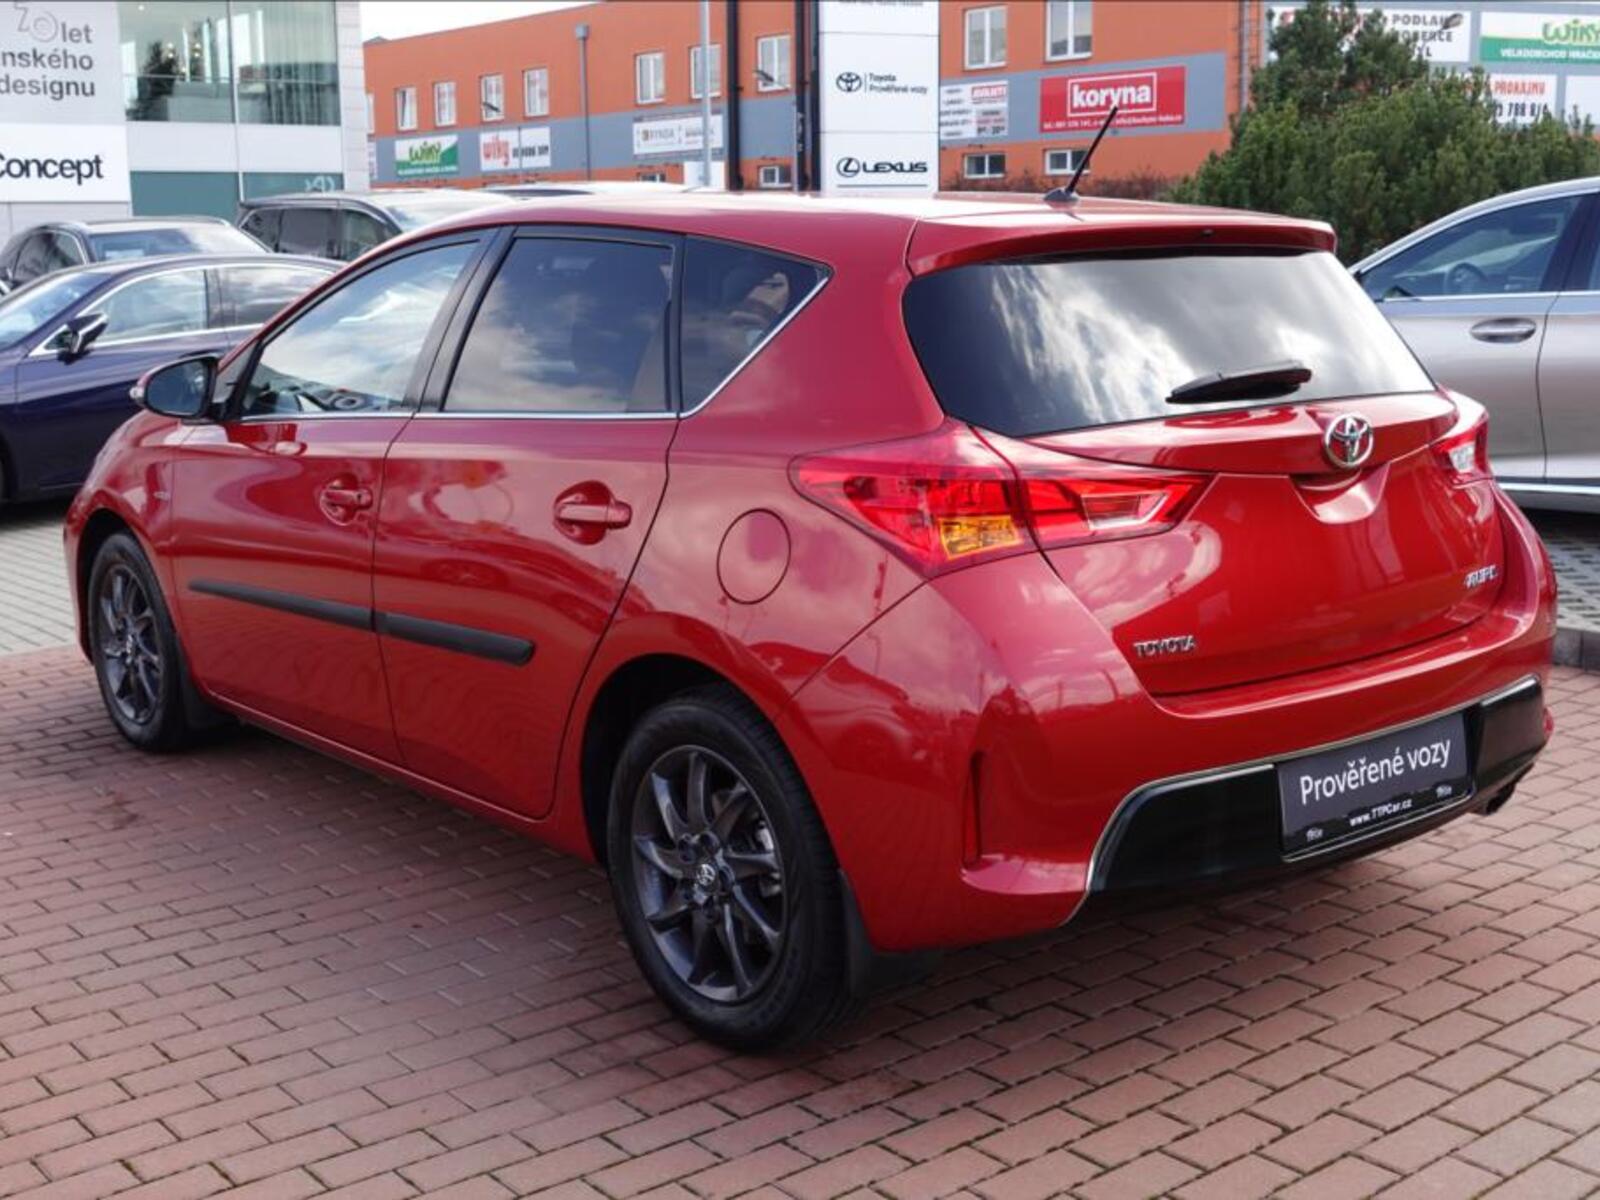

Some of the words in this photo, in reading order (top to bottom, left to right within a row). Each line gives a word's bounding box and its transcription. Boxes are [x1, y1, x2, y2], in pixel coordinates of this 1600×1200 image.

[61, 22, 93, 44] let
[0, 74, 95, 101] designu
[1072, 83, 1151, 110] koryna
[863, 162, 928, 173] LEXUS
[1133, 635, 1195, 657] TOYOTA
[1300, 747, 1405, 805] Prověřené
[1407, 739, 1451, 769] vozy
